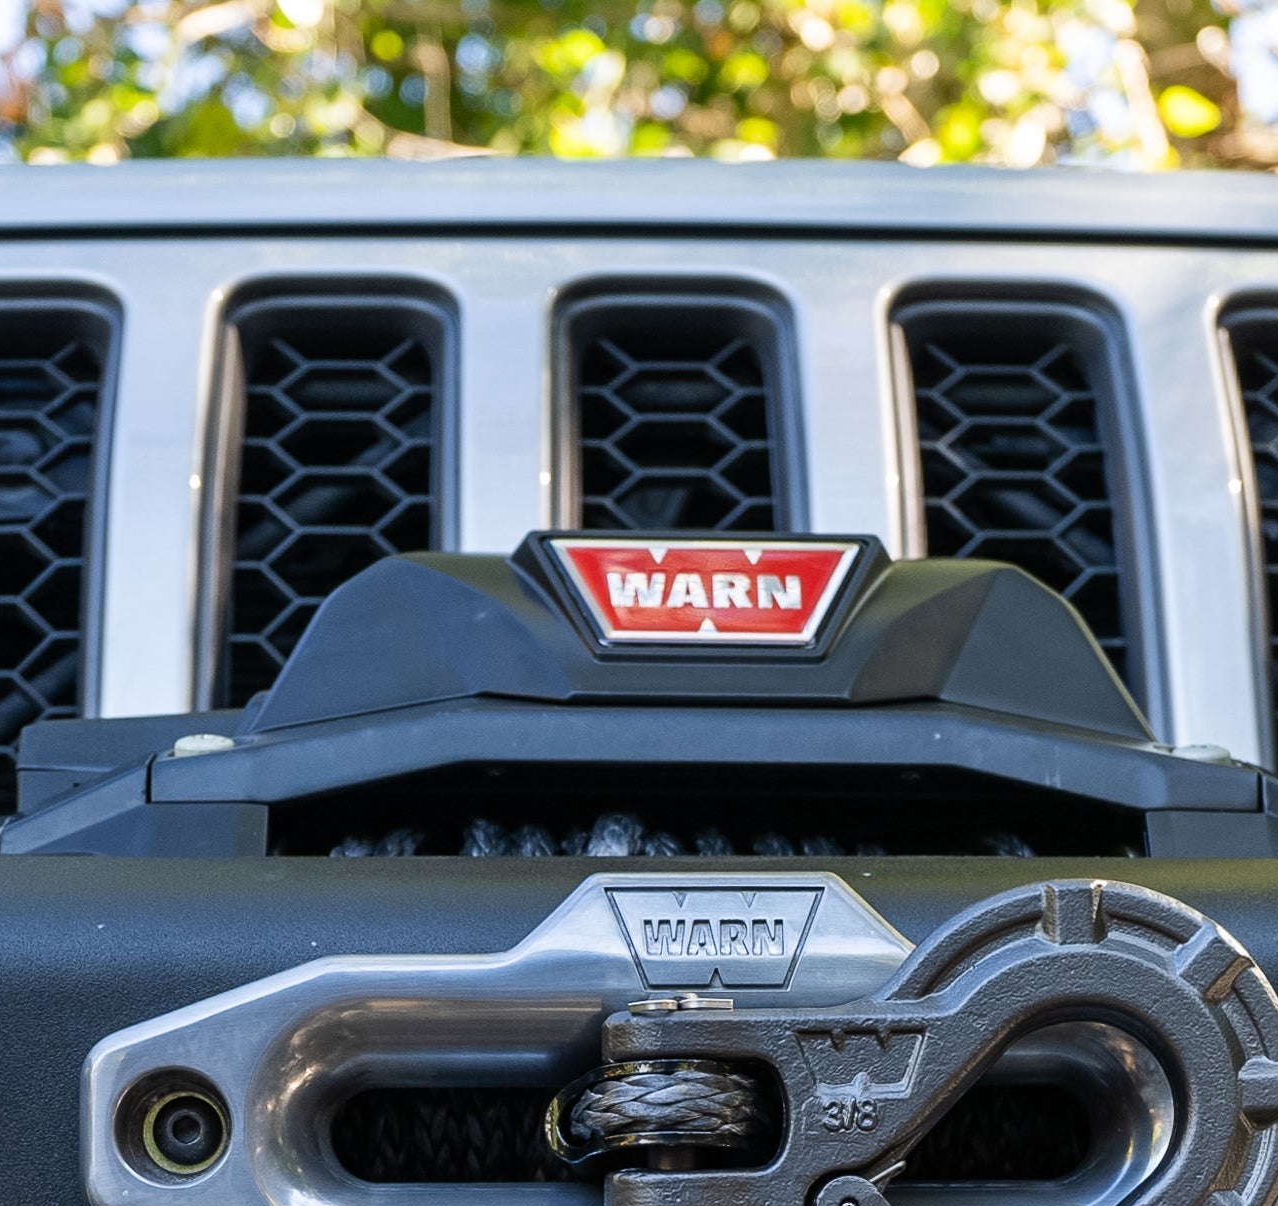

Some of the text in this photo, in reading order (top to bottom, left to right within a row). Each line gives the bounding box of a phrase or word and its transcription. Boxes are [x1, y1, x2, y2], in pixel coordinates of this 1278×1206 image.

[606, 572, 803, 610] WARN
[643, 919, 785, 956] WARN
[823, 1099, 878, 1132] 3/8
